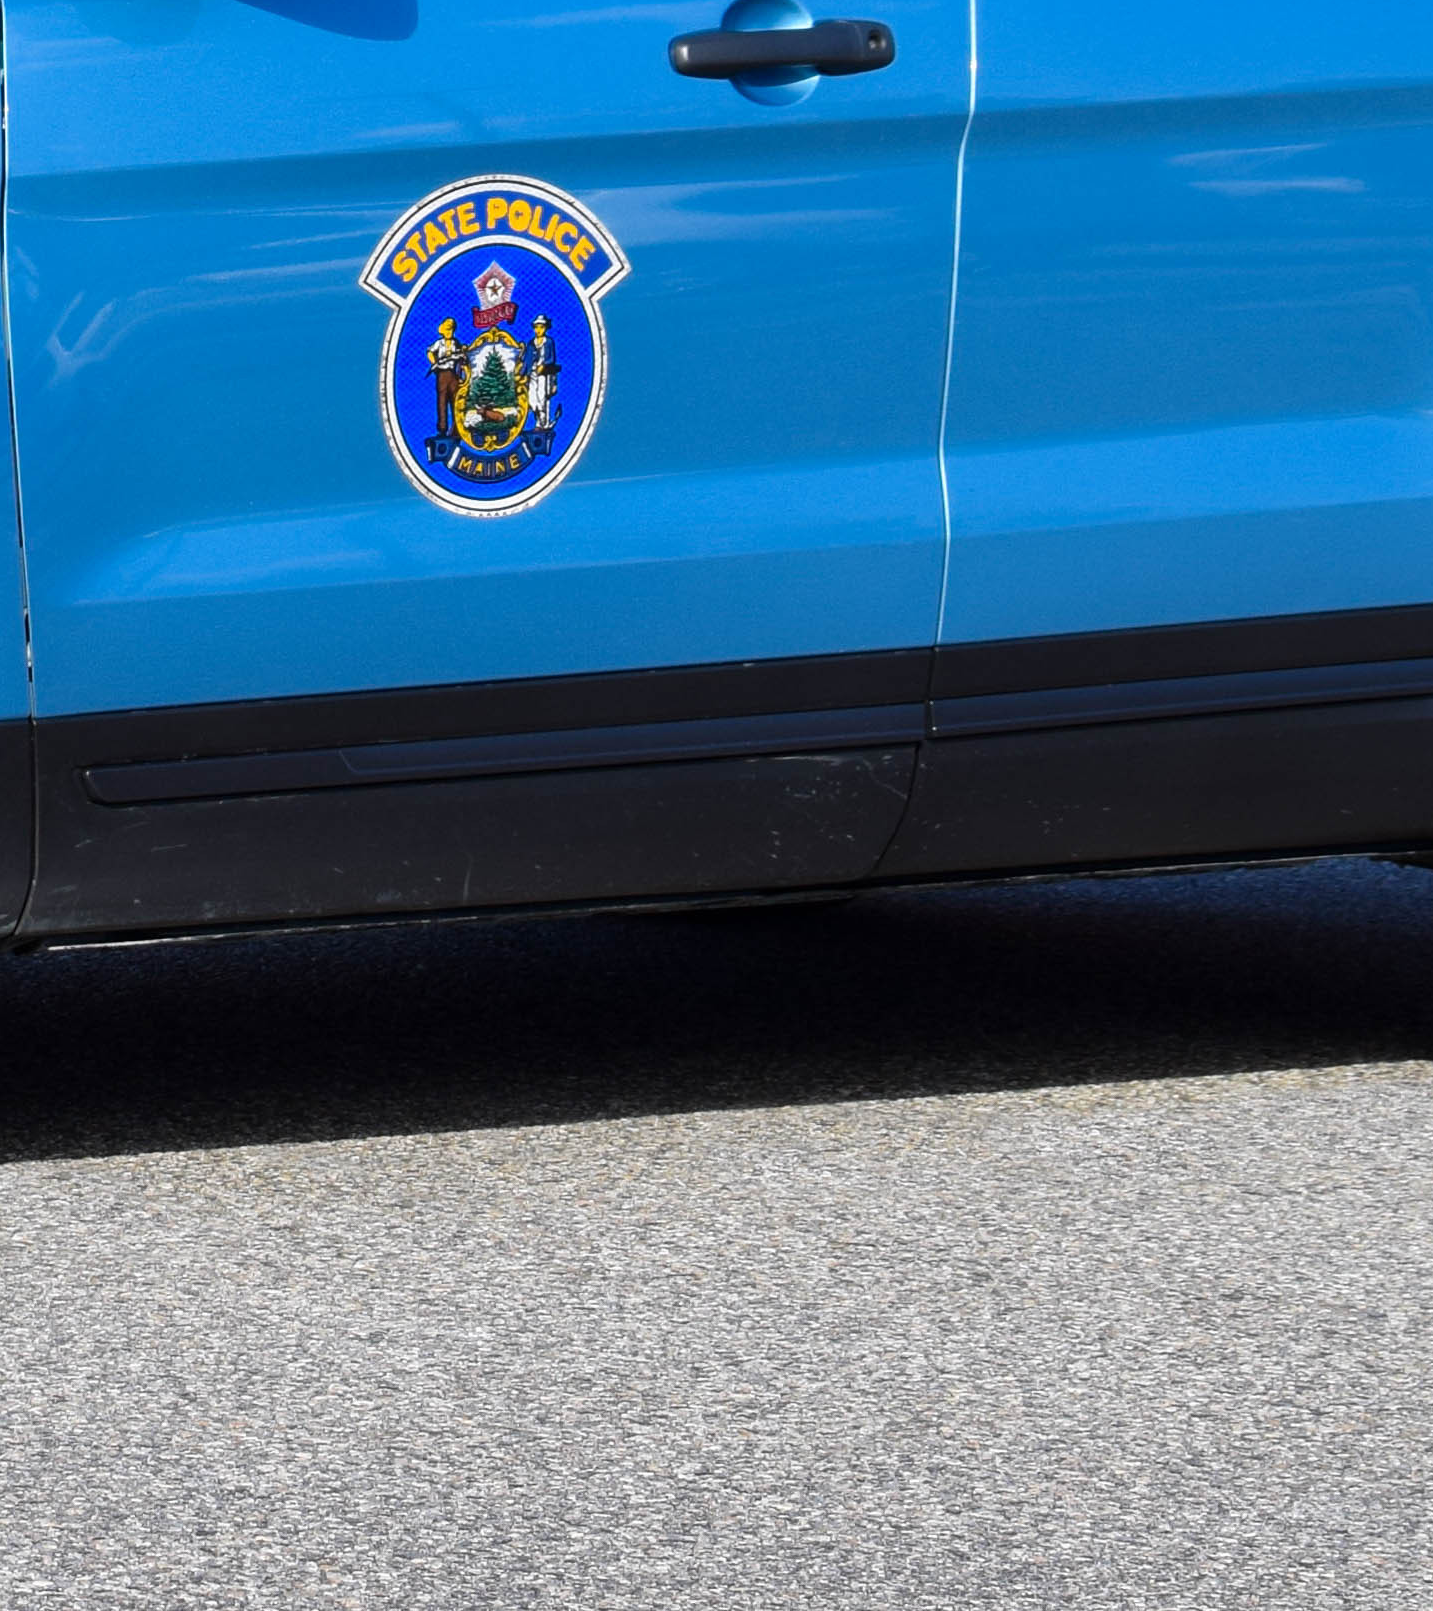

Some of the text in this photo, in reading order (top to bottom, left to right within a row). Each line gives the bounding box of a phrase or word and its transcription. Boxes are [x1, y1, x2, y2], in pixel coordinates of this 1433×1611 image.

[391, 198, 596, 282] STATE POLICE
[458, 454, 521, 476] MAINE
